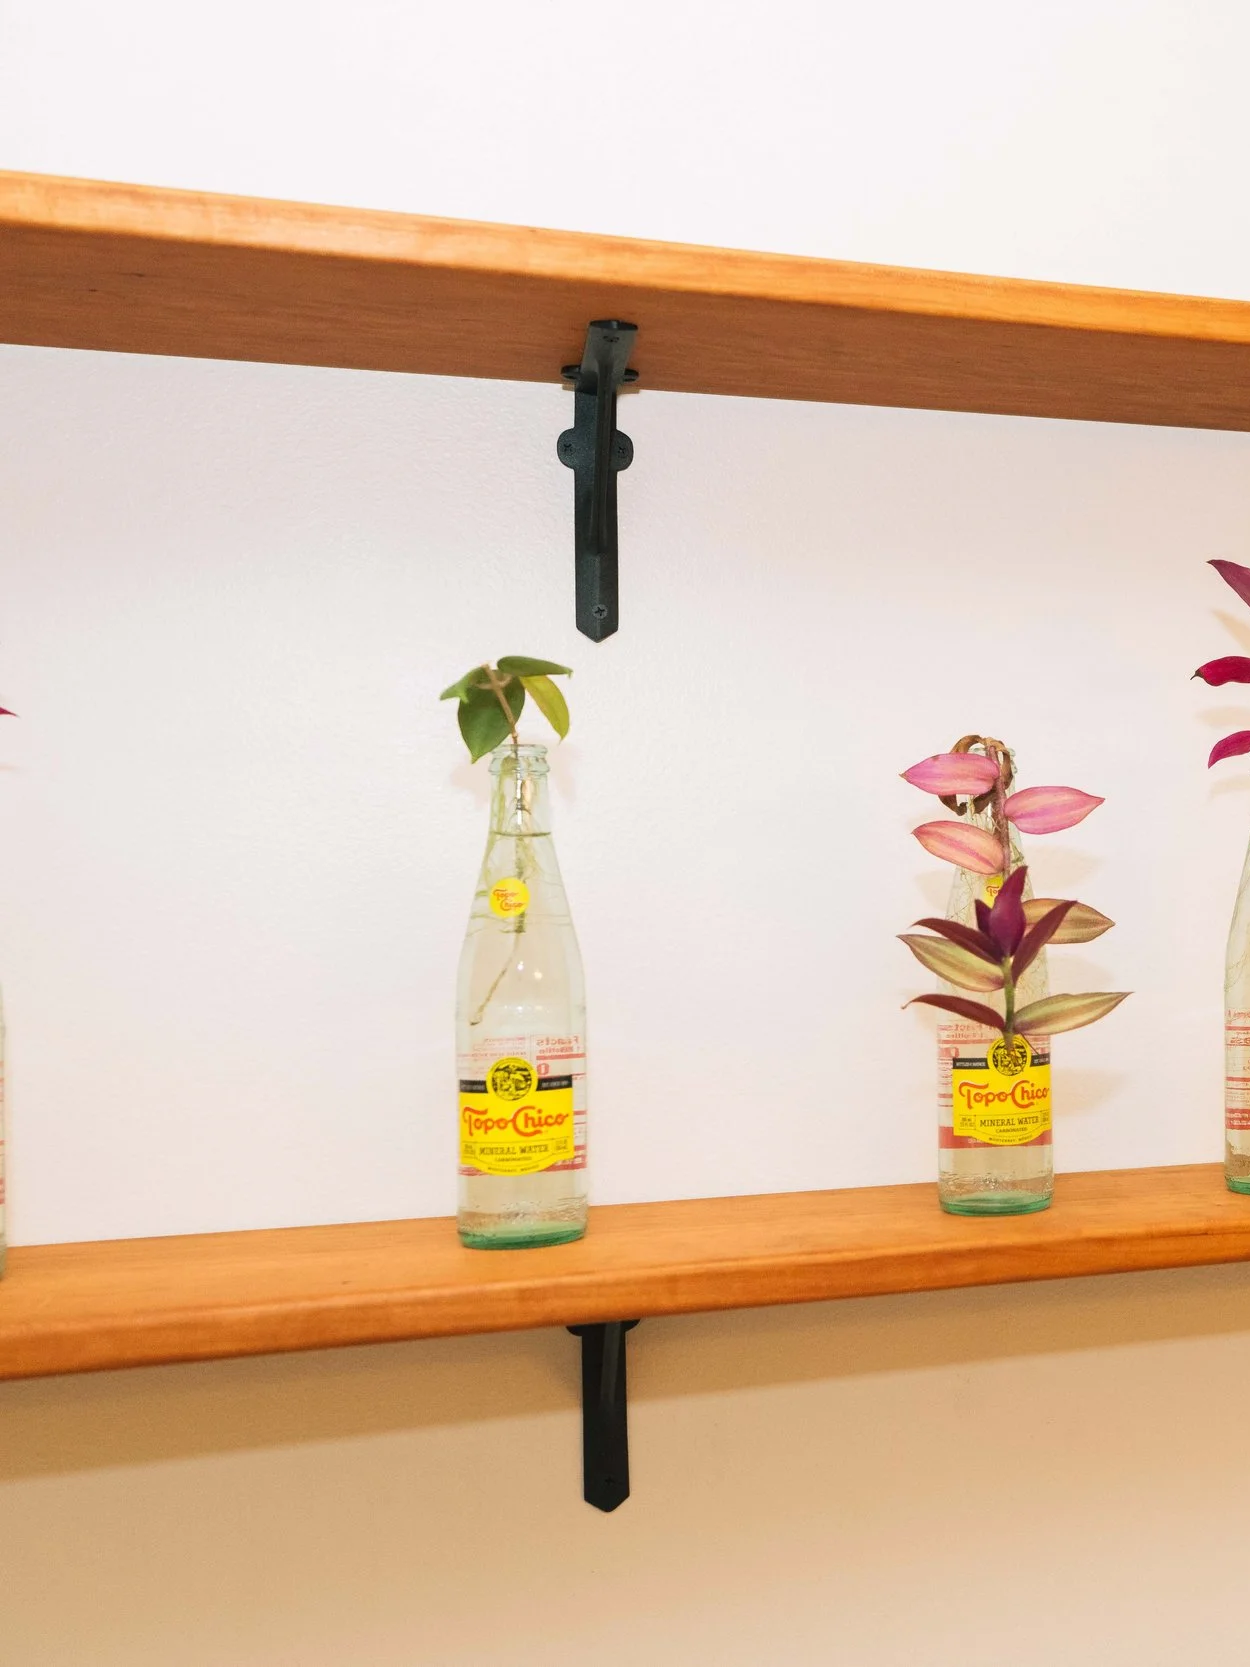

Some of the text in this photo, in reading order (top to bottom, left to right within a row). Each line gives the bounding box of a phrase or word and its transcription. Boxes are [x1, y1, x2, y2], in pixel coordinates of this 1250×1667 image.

[958, 1080, 1050, 1109] Topo Chico
[462, 1105, 569, 1137] Topo Chico
[980, 1118, 1016, 1128] MINERAL
[1017, 1116, 1039, 1125] WATER
[479, 1145, 517, 1156] MINERAL
